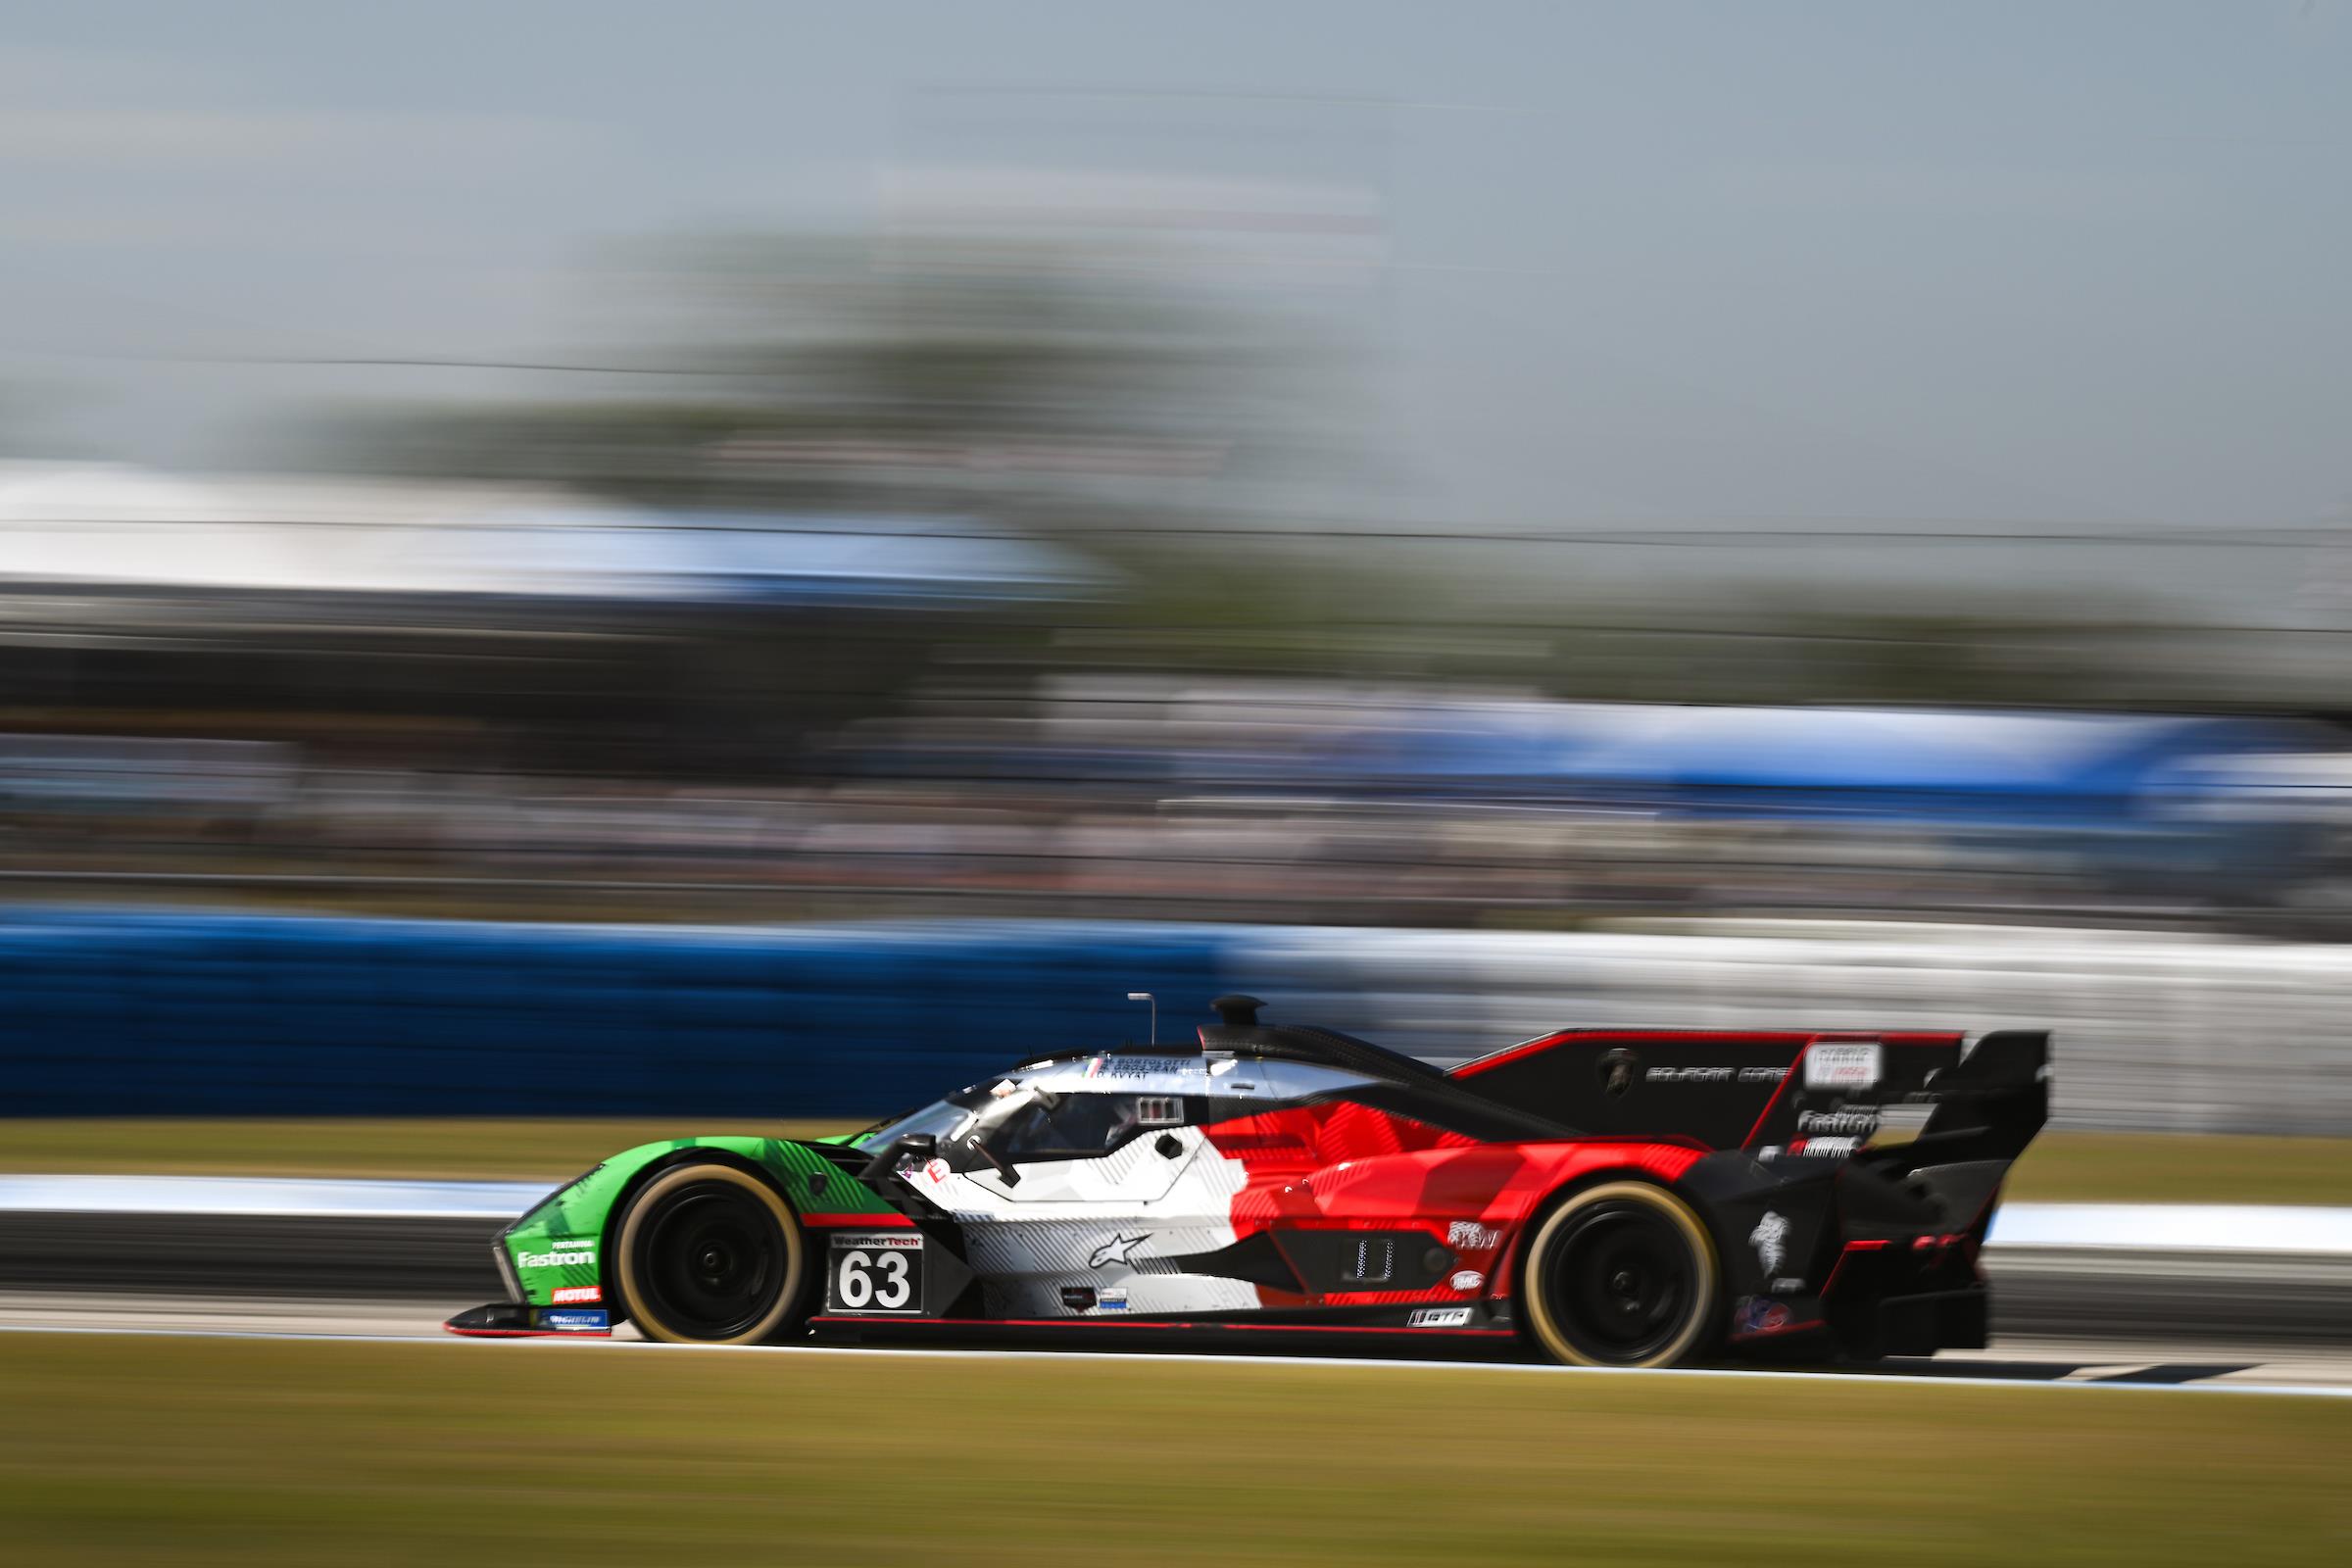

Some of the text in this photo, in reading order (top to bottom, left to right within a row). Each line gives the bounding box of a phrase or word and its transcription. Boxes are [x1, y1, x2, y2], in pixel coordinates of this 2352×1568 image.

[1110, 1070, 1150, 1079] KVYAT
[1113, 1064, 1179, 1074] GROSJEAN
[927, 1160, 947, 1183] E
[833, 1236, 920, 1247] WeatherTech
[517, 1251, 597, 1268] Fastron
[839, 1250, 910, 1308] 63
[553, 1288, 601, 1301] MOTUL
[549, 1315, 601, 1324] MICHELIN
